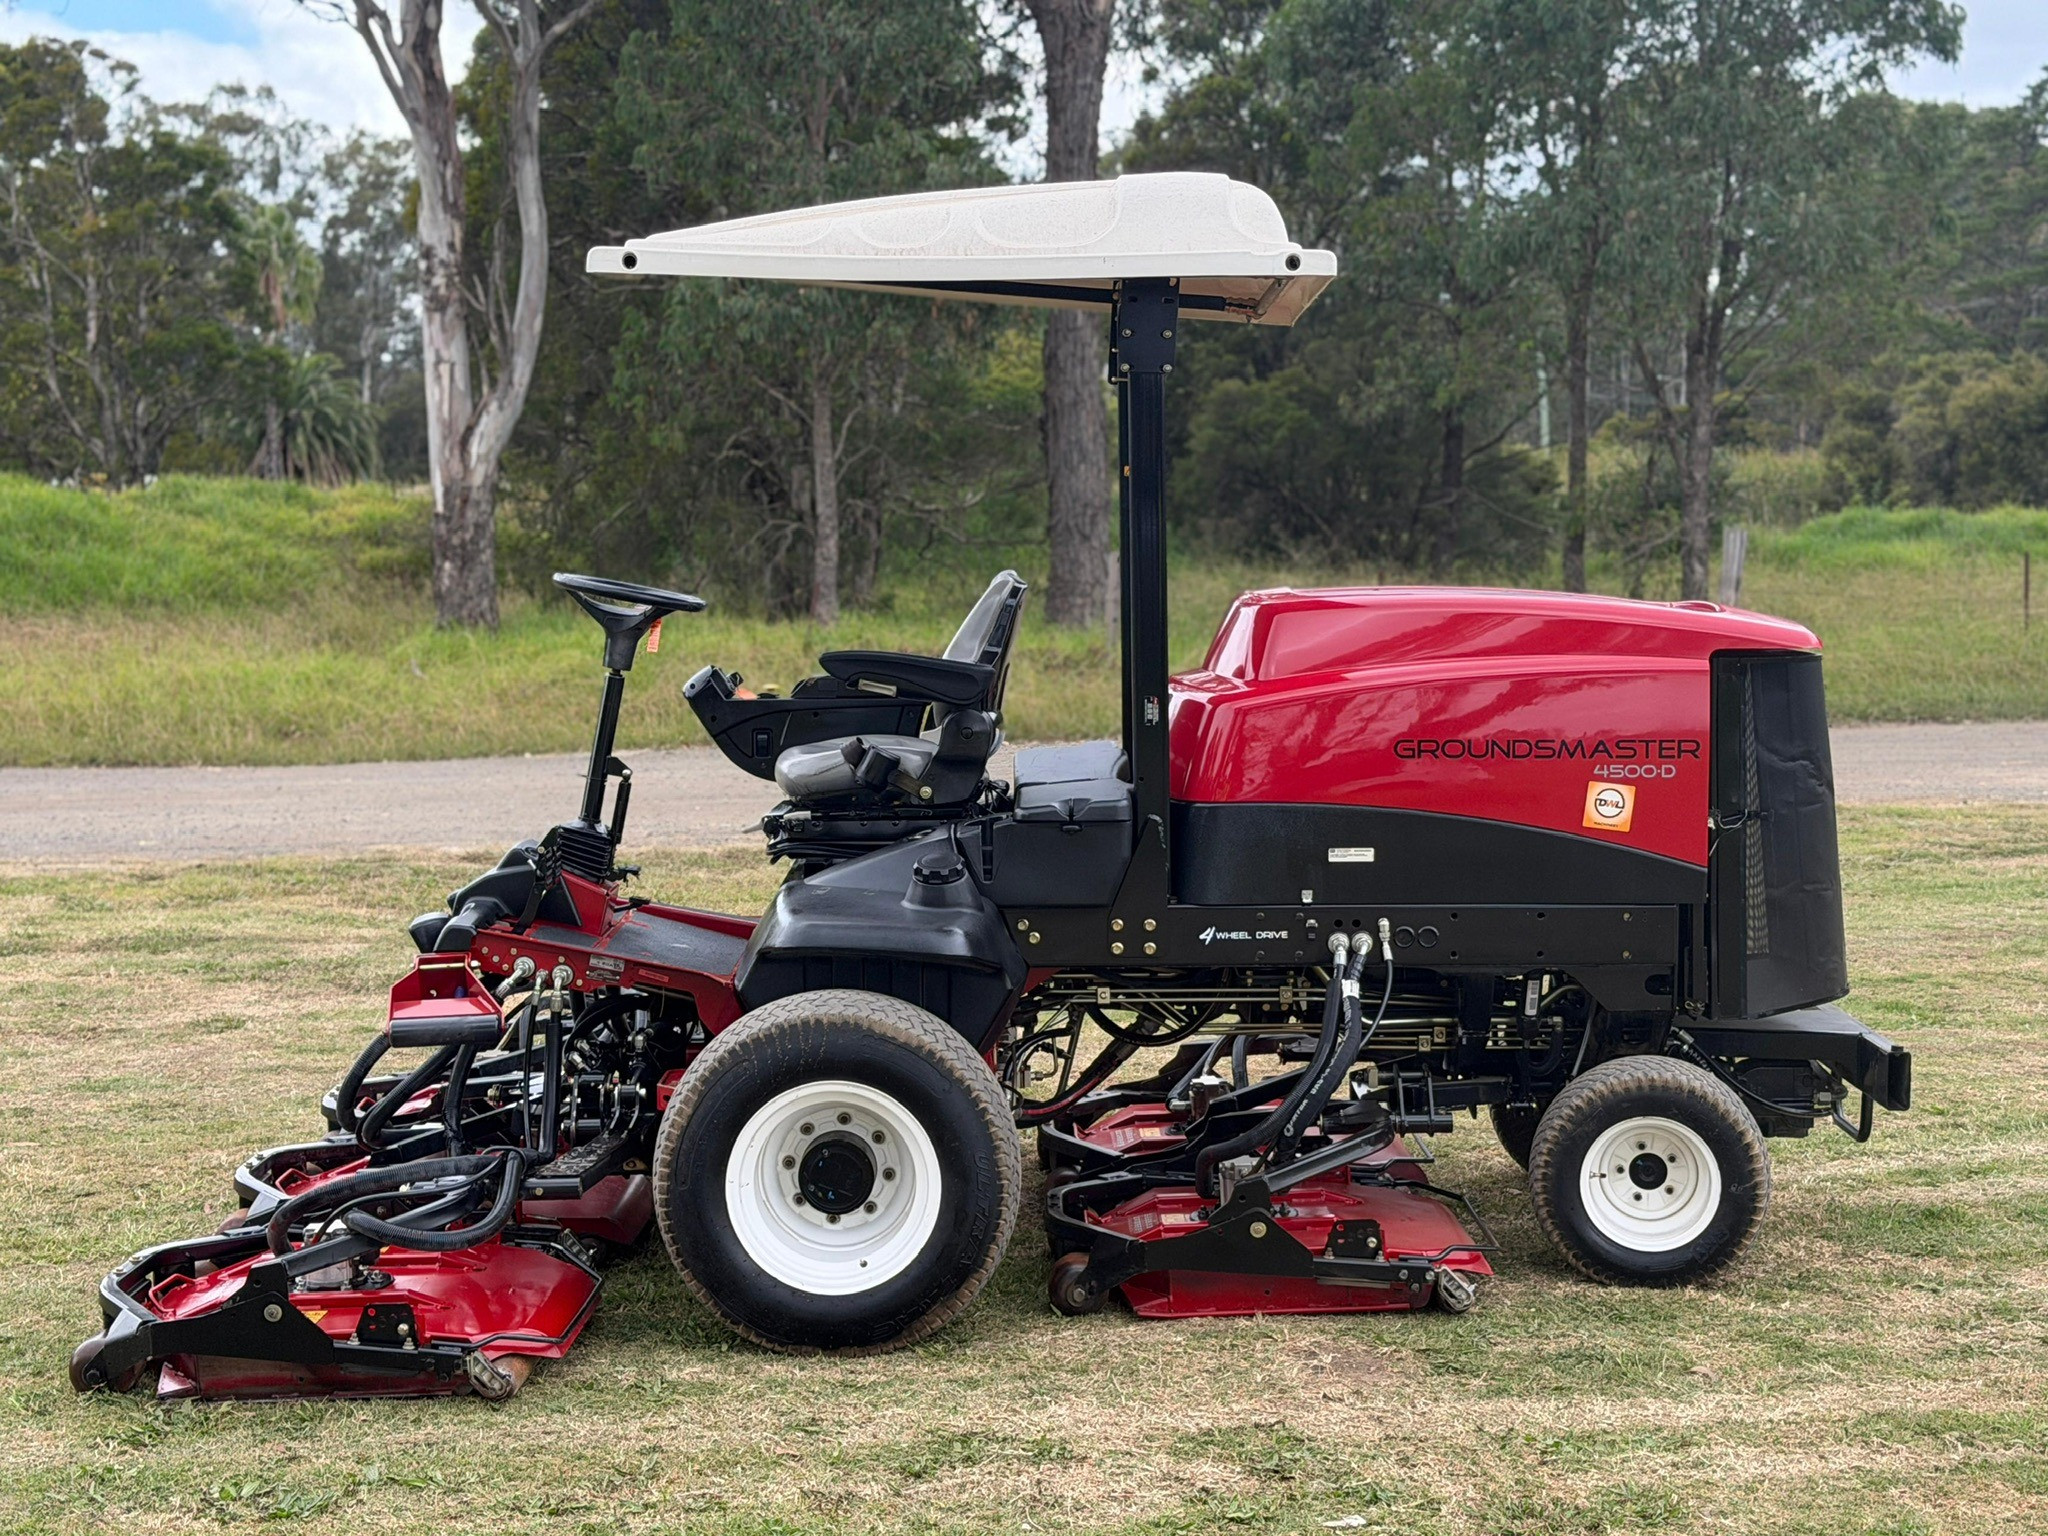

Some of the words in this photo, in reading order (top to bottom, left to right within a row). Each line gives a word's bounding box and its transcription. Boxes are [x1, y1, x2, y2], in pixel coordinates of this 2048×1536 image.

[1393, 739, 1701, 759] GROUNDSMASTER
[1199, 926, 1216, 946] 4
[1215, 931, 1252, 940] WHEEL
[1255, 930, 1289, 940] DRIVE
